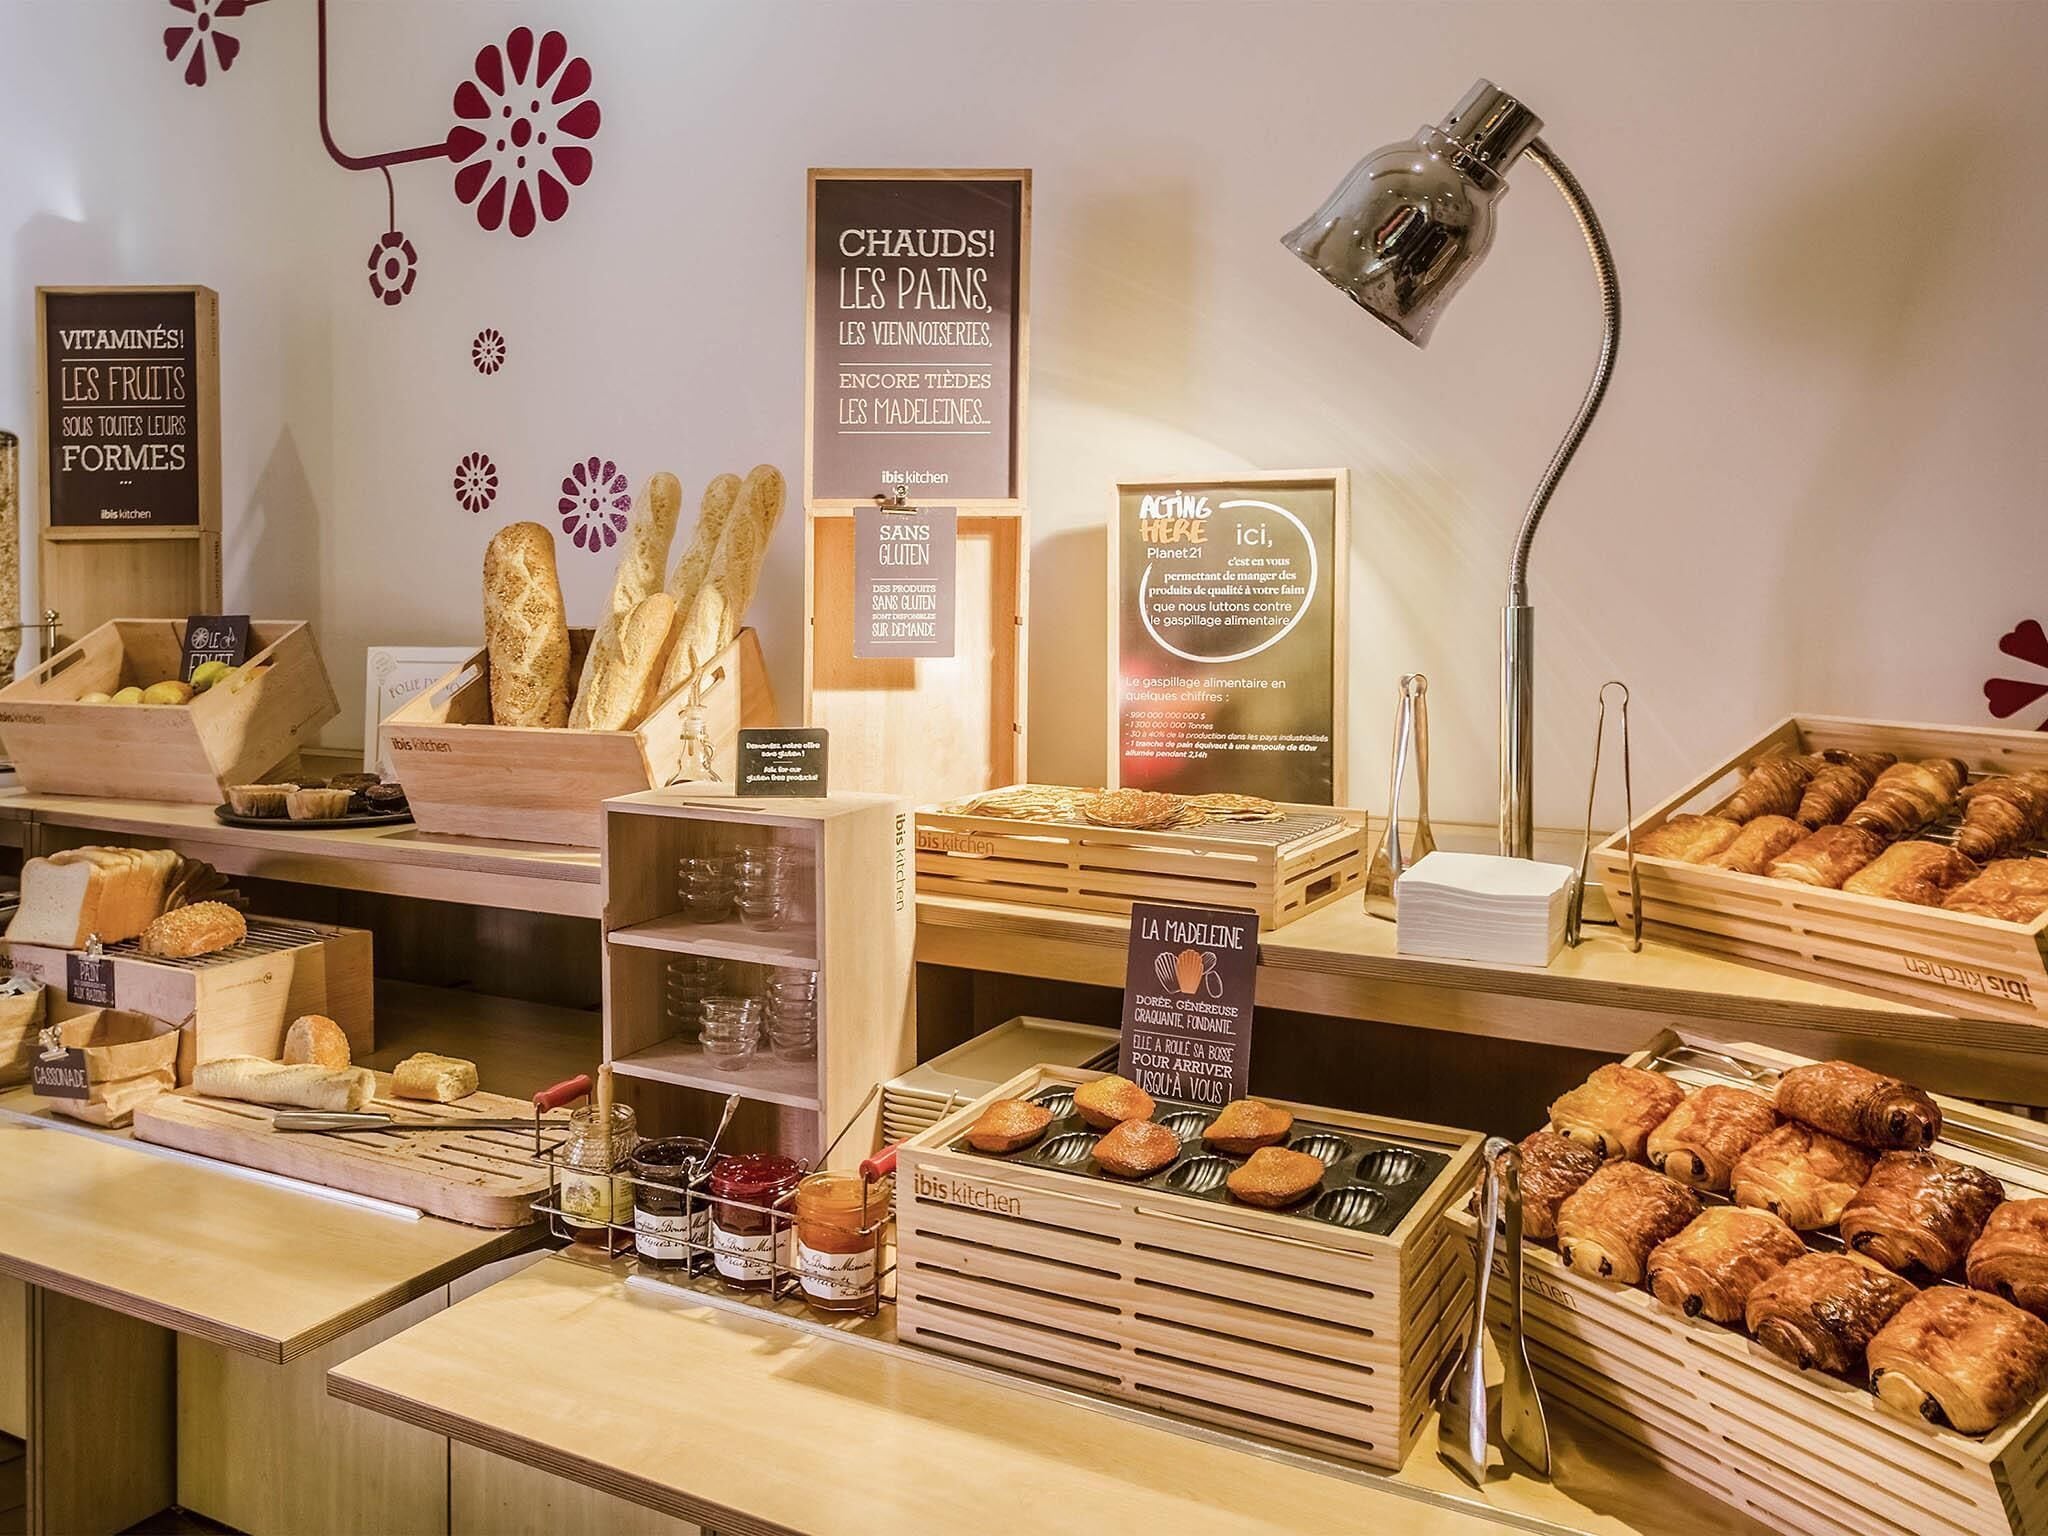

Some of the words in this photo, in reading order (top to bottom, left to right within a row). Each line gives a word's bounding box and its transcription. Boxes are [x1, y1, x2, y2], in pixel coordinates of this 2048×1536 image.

[839, 229, 995, 257] CHAUDS!
[839, 267, 886, 310] LES
[898, 267, 993, 313] PAINS,
[60, 323, 184, 350] VITAMINÉS!
[839, 322, 865, 345] LES
[872, 322, 993, 348] VIENNOISERIES,
[62, 367, 99, 401] LES
[108, 366, 186, 400] FRUITS
[839, 374, 920, 389] ENCORE
[925, 369, 991, 389] TIÈDES
[839, 398, 867, 425] LES
[62, 416, 93, 437] SOUS
[98, 416, 143, 437] TOUTES
[147, 415, 186, 436] LEURS
[62, 444, 186, 472] FORMES
[882, 471, 904, 483] ibis
[906, 471, 948, 483] kitchen
[101, 509, 118, 519] ibis
[119, 509, 151, 519] kitchen
[880, 525, 930, 541] SANS
[1139, 518, 1208, 544] HERE
[1237, 523, 1273, 548] ici,
[879, 543, 930, 566] GLUTEN
[1228, 556, 1250, 566] c'est
[1251, 558, 1264, 566] en
[1265, 558, 1290, 566] vous
[1164, 572, 1221, 583] permettant
[1222, 571, 1236, 581] de
[1237, 572, 1277, 583] manger
[1279, 571, 1296, 580] des
[872, 584, 891, 593] DES
[892, 584, 936, 593] PRODUITS
[1149, 585, 1192, 597] produits
[1194, 586, 1206, 595] de
[1208, 585, 1243, 597] qualité
[1244, 585, 1251, 595] à
[1252, 586, 1279, 595] votre
[1281, 585, 1304, 595] faim
[872, 595, 898, 610] SANS
[901, 595, 936, 610] GLUTEN
[1153, 604, 1175, 614] que
[1178, 604, 1207, 612] nous
[1209, 602, 1249, 612] luttons
[1253, 603, 1292, 612] contre
[872, 622, 889, 637] SUR
[891, 622, 936, 637] DEMANDE
[1150, 616, 1160, 625] le
[1164, 616, 1221, 627] gaspillage
[1224, 616, 1290, 626] alimentaire
[1126, 677, 1139, 687] Le
[1143, 677, 1200, 689] gaspillage
[1203, 677, 1268, 688] alimentaire
[1271, 680, 1286, 688] en
[1126, 692, 1177, 702] quelques
[1180, 690, 1222, 701] chiffres
[1188, 722, 1213, 730] Tonnes
[391, 737, 413, 751] ibis
[413, 737, 452, 753] kitchen
[1135, 740, 1164, 748] tranche
[1176, 741, 1193, 749] pain
[1251, 743, 1286, 751] ampoule
[1186, 732, 1227, 740] production
[1247, 733, 1258, 741] les
[1259, 734, 1278, 742] pays
[1125, 749, 1155, 757] allumée
[1155, 750, 1187, 758] pendant
[895, 813, 906, 846] ibis
[942, 834, 995, 855] kitchen
[895, 848, 907, 912] kitchen
[1141, 917, 1160, 941] LA
[1165, 920, 1245, 950] MADELEINE
[1903, 956, 1986, 993] kitchen
[1987, 975, 2033, 1003] ibis
[1176, 999, 1239, 1017] GÉNÉREUSE
[1132, 1034, 1152, 1051] ELLE
[1155, 1039, 1162, 1052] A
[1165, 1036, 1190, 1057] ROULÉ
[1193, 1044, 1205, 1059] SA
[1208, 1046, 1234, 1063] BOSSE
[1132, 1052, 1170, 1069] POUR
[1172, 1057, 1233, 1079] ARRIVER
[34, 1065, 88, 1089] CASSONADE
[1190, 1077, 1223, 1105] VOUS
[914, 1173, 947, 1200] ibis
[952, 1181, 1021, 1215] kitchen
